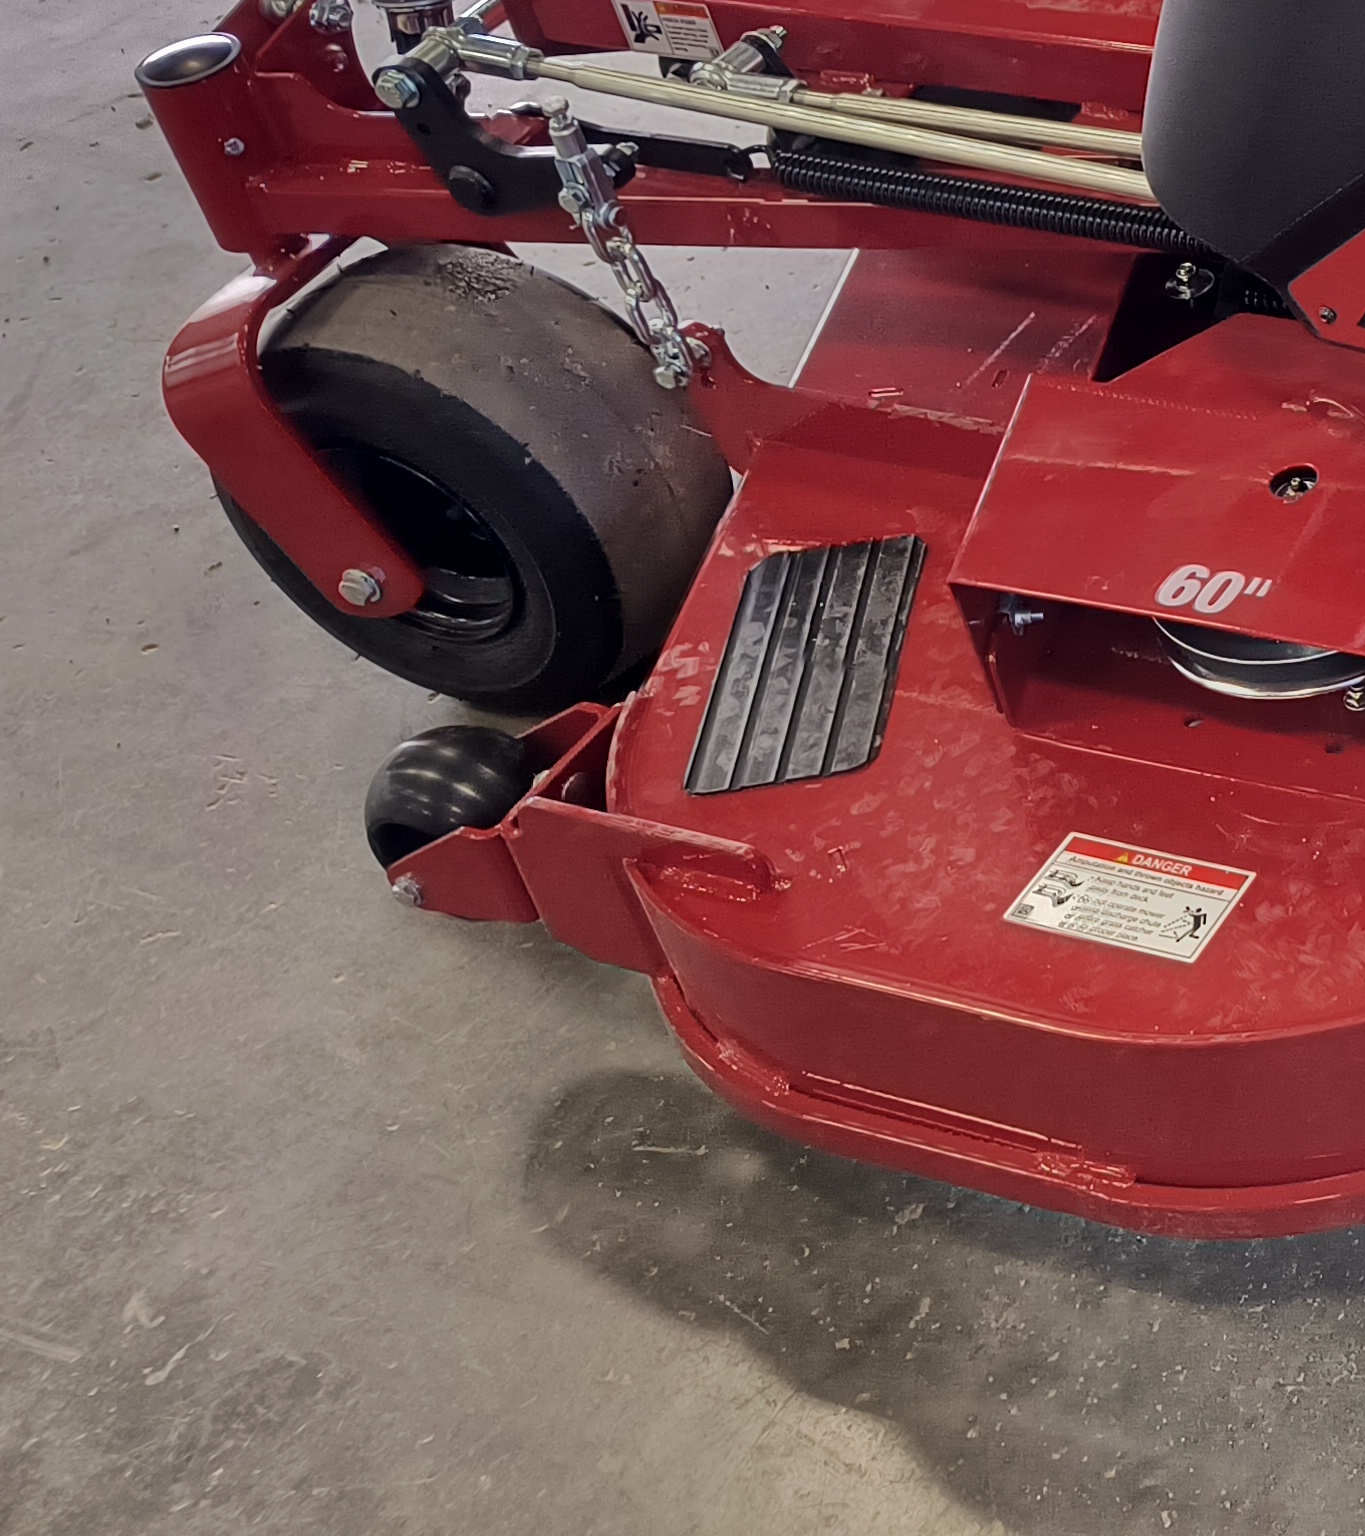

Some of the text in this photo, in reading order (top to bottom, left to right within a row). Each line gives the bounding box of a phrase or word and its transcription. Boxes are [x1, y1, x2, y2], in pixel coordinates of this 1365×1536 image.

[1155, 564, 1273, 614] 60"
[1067, 856, 1116, 871] Amputation
[1117, 867, 1134, 875] and
[1194, 883, 1224, 896] hazard
[1131, 854, 1193, 876] DANGER
